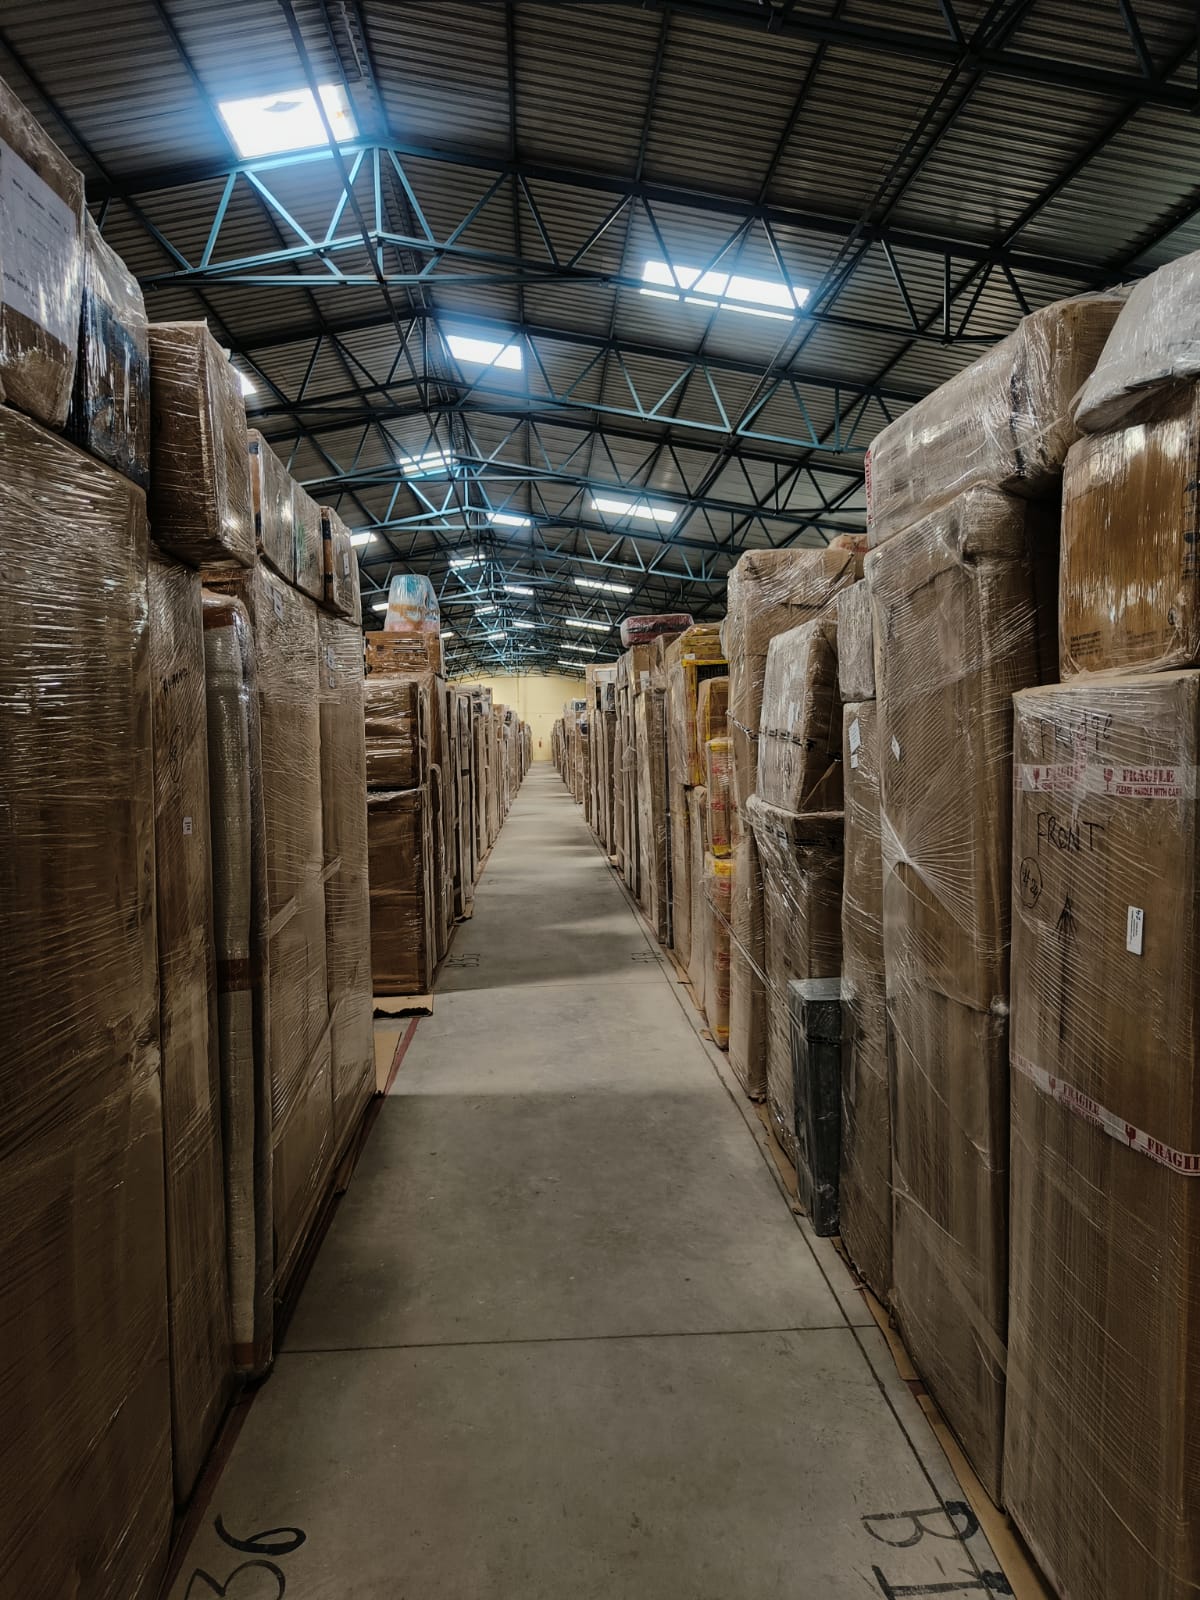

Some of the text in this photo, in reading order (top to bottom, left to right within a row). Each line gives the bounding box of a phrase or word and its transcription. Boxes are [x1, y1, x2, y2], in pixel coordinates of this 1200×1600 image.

[1122, 769, 1175, 783] FRAGILE
[1153, 787, 1167, 797] WITH
[1037, 811, 1105, 856] FRONT
